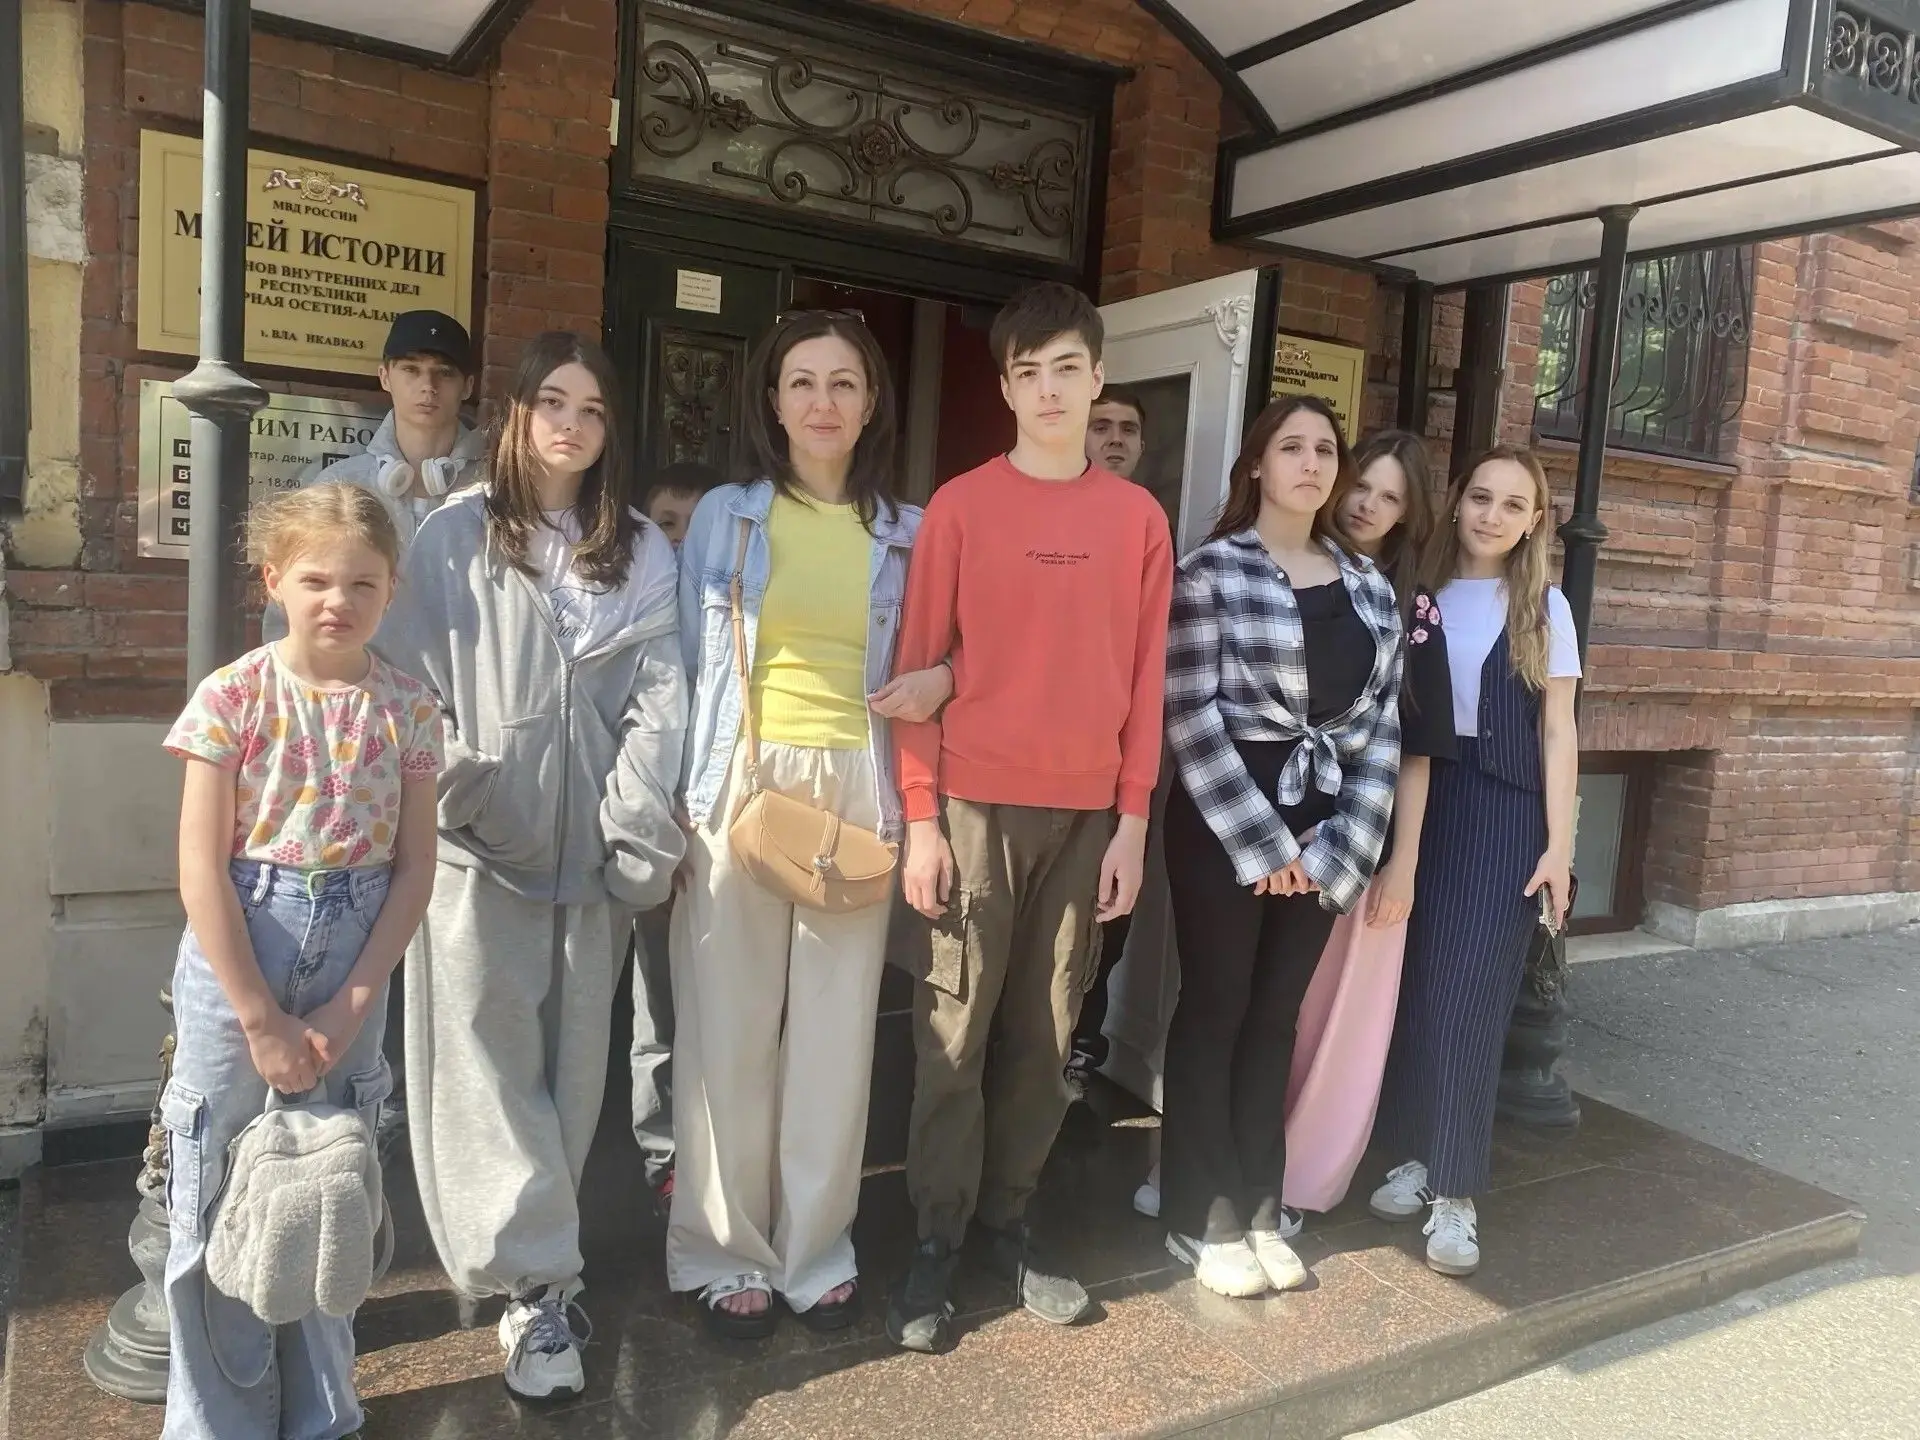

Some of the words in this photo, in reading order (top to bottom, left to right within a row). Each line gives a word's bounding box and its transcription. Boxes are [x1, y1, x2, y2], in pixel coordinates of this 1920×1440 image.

[272, 200, 300, 214] МВД
[304, 205, 357, 222] РОССИИ
[174, 208, 290, 252] МЕЙ
[301, 229, 446, 277] ИСТОРИИ
[260, 278, 367, 304] РЕСПУБЛИКИ
[281, 265, 387, 291] ВНУТРЕННИХ
[390, 282, 420, 296] ДЕЛ
[289, 298, 400, 323] ОСЕТИЯ-АЛАН
[309, 423, 375, 446] РАБО
[282, 454, 313, 465] день
[268, 477, 301, 488] 18:00
